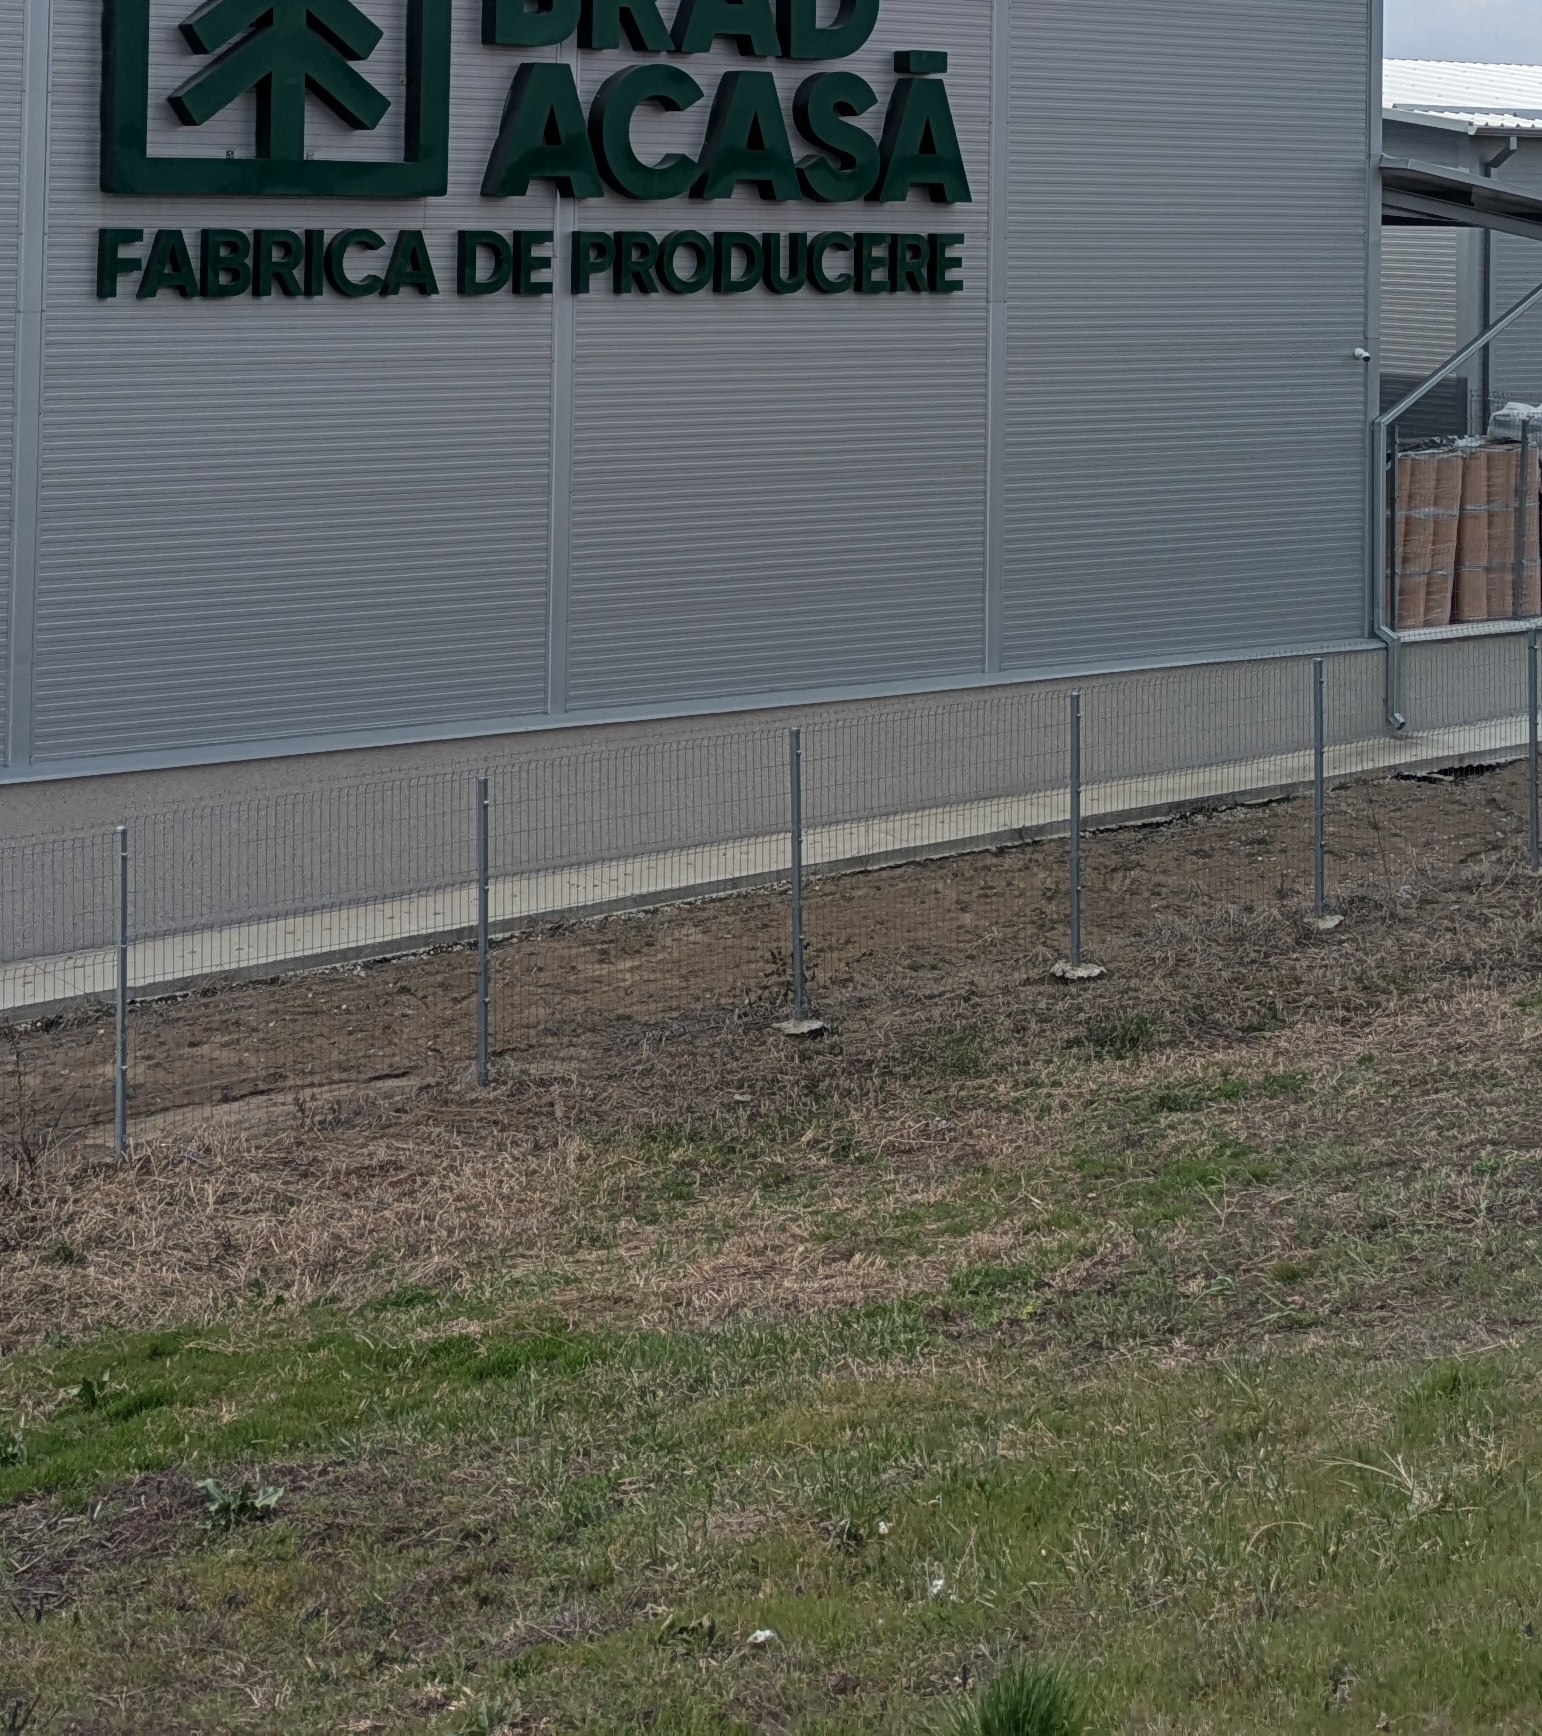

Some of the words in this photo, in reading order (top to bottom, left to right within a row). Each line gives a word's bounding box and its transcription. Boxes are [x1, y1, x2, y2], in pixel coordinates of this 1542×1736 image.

[97, 228, 440, 299] FABRICA
[457, 229, 555, 297] DE
[571, 230, 965, 295] PRODUCERE
